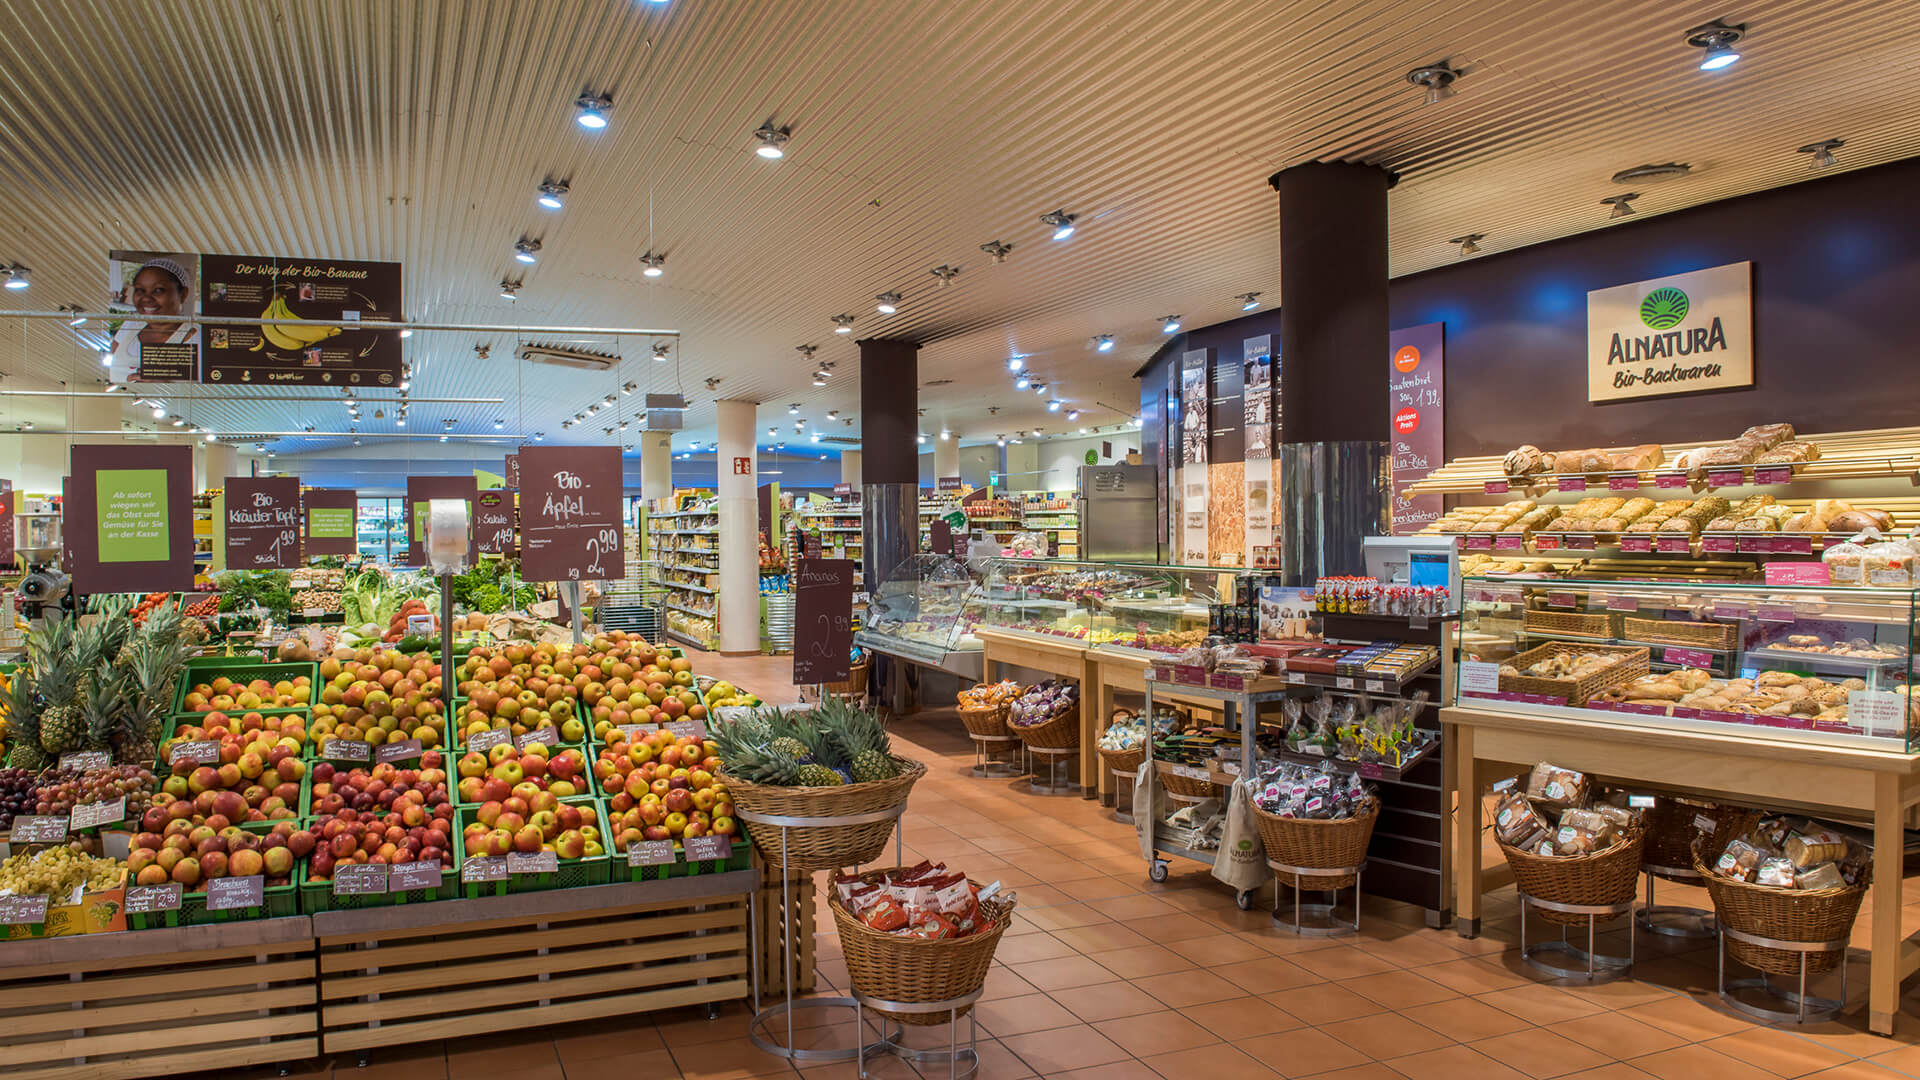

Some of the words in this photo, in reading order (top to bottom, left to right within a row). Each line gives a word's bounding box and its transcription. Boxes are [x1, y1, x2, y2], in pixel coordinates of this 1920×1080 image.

[235, 263, 255, 275] Der
[258, 264, 279, 280] Weg
[282, 265, 302, 277] der
[1608, 316, 1727, 366] ALNATURA
[1613, 363, 1722, 389] Bio-Backwaren
[1395, 412, 1417, 423] Aktions
[1399, 421, 1413, 430] Preis
[113, 491, 126, 500] Ab
[128, 491, 152, 500] sofort
[110, 501, 140, 511] wiegen
[142, 501, 156, 510] wir
[542, 492, 584, 521] Äpfel
[106, 511, 121, 520] das
[122, 511, 142, 520] Obst
[143, 511, 160, 520] und
[229, 509, 273, 523] Kräuter
[103, 521, 135, 530] Gemüse
[137, 520, 150, 530] für
[151, 520, 164, 529] Sie
[107, 531, 119, 539] an
[120, 530, 135, 539] der
[136, 530, 159, 539] Kasse
[568, 567, 580, 580] kg
[801, 563, 841, 582] Ananas
